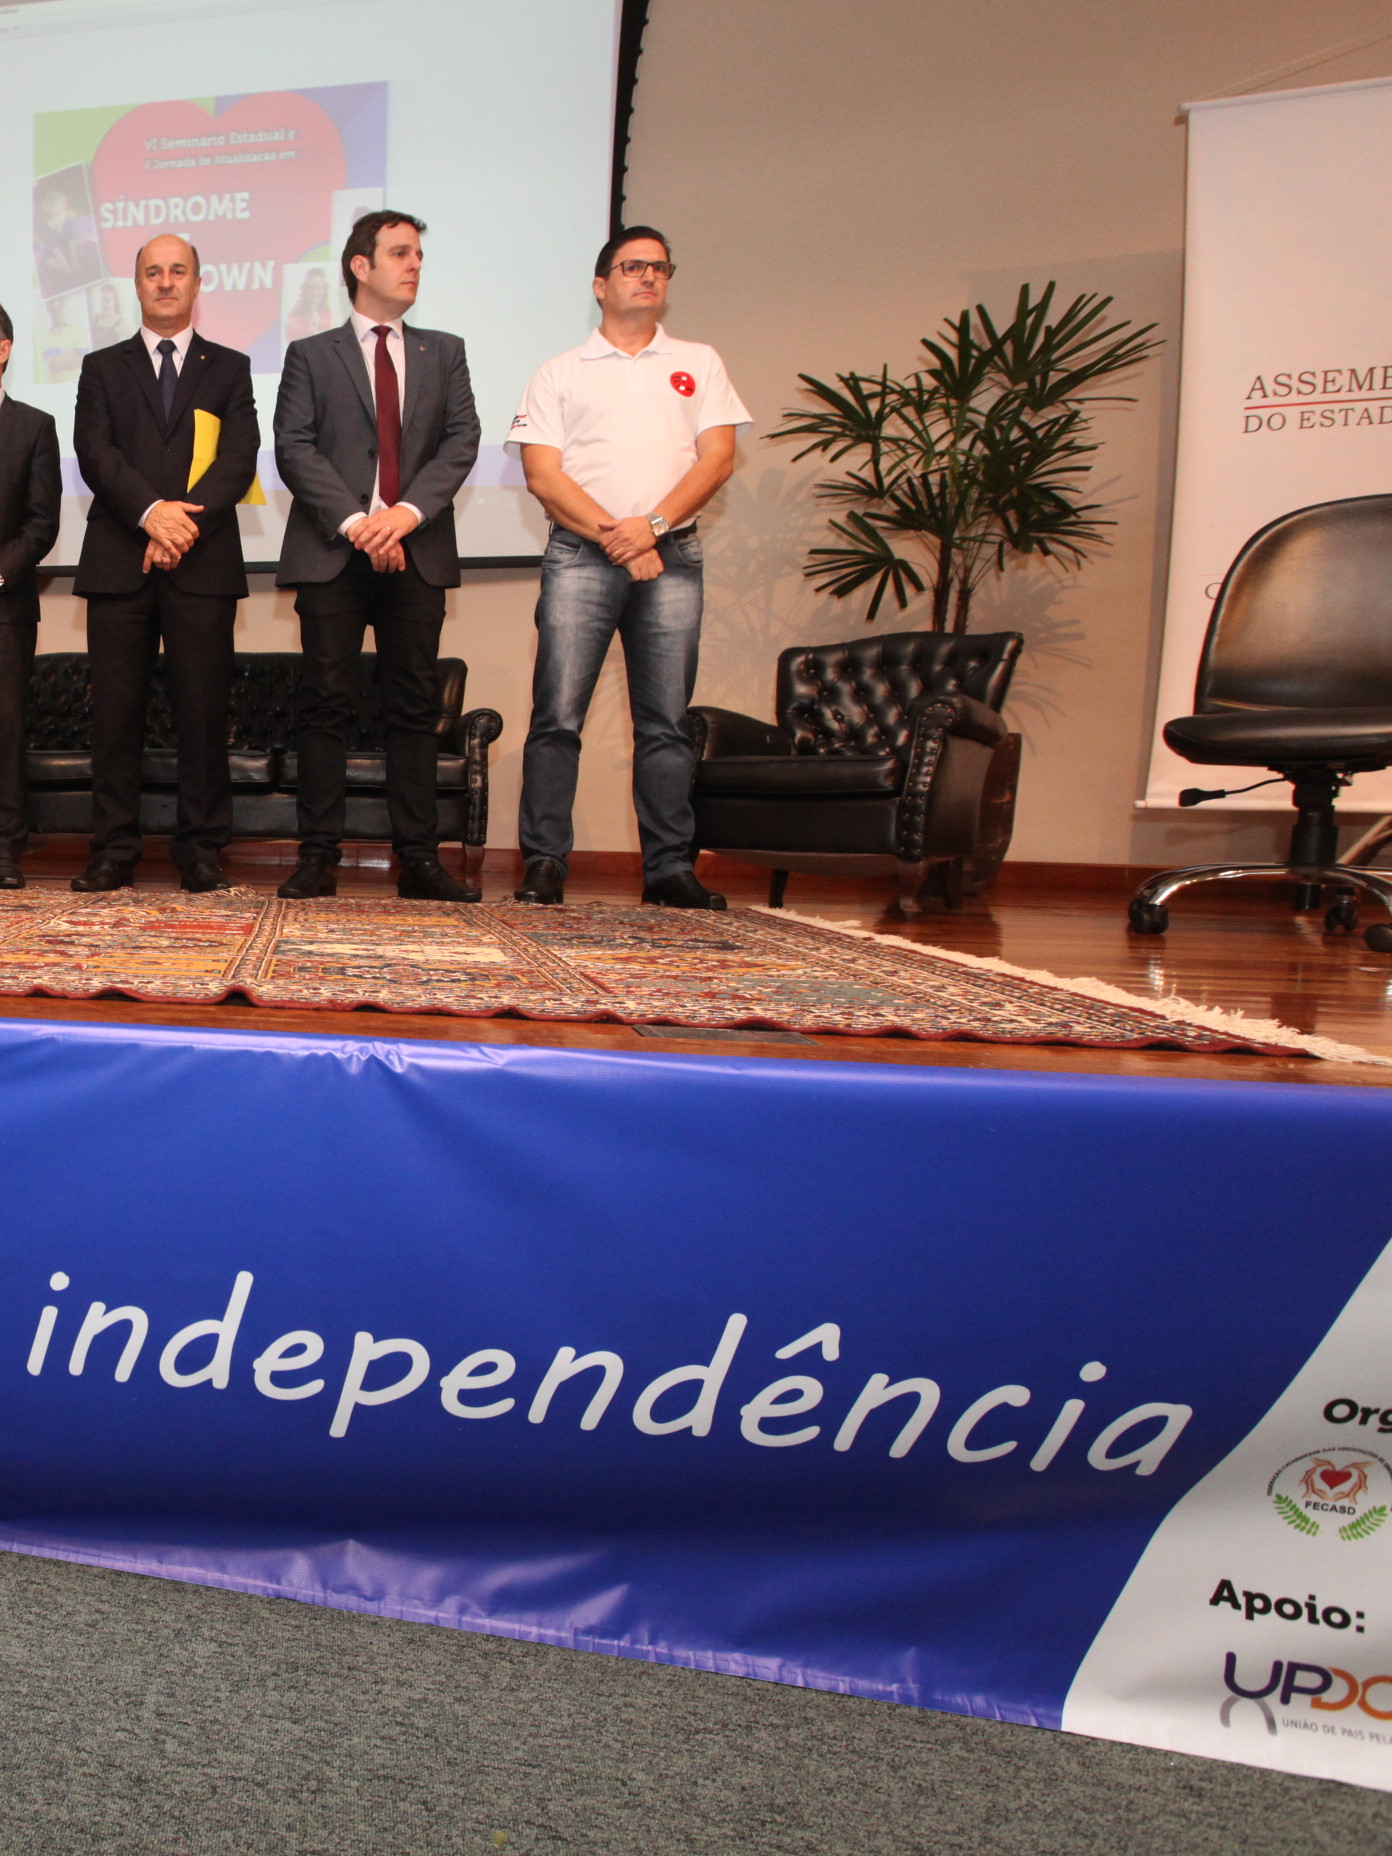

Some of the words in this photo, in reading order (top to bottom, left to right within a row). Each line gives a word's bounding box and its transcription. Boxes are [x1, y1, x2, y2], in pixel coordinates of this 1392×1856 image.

[144, 138, 158, 151] VI
[229, 128, 285, 146] Estadual
[153, 157, 196, 170] Jornada
[198, 156, 212, 166] de
[279, 150, 296, 160] em
[99, 191, 251, 229] SÍNDROME
[199, 260, 276, 293] OWN
[1243, 412, 1286, 434] DO
[25, 1270, 1194, 1476] independência
[1304, 1500, 1357, 1516] FECASD
[1209, 1578, 1365, 1634] Apoio:
[1281, 1717, 1318, 1732] UNIÃO
[1322, 1723, 1336, 1736] DE
[1341, 1727, 1366, 1740] PAIS
